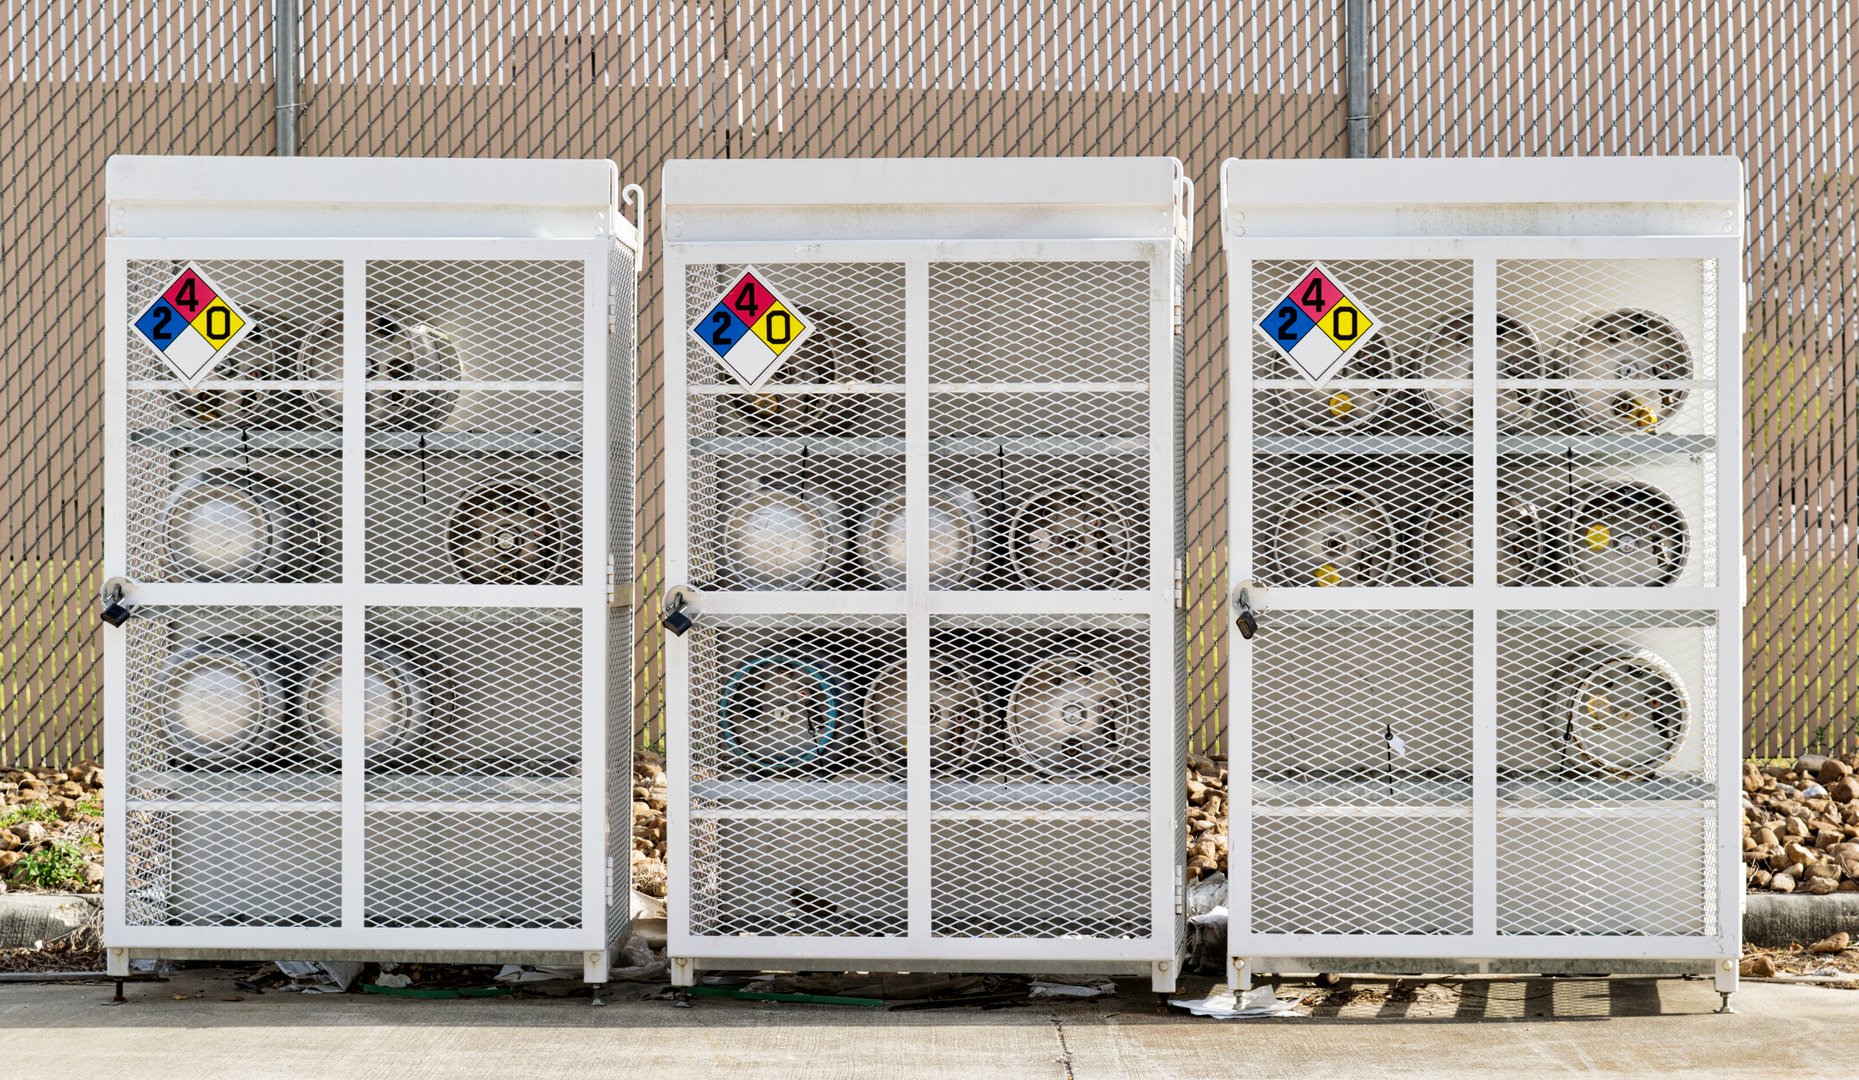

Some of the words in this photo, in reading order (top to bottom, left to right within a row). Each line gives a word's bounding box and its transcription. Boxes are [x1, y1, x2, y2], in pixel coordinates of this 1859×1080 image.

[175, 277, 199, 312] 4
[734, 282, 759, 317] 4
[1301, 277, 1326, 313] 4
[152, 305, 172, 340] 2
[206, 306, 231, 340] 0
[712, 310, 732, 346] 2
[766, 310, 791, 345] 0
[1277, 306, 1298, 341] 2
[1333, 306, 1358, 341] 0
